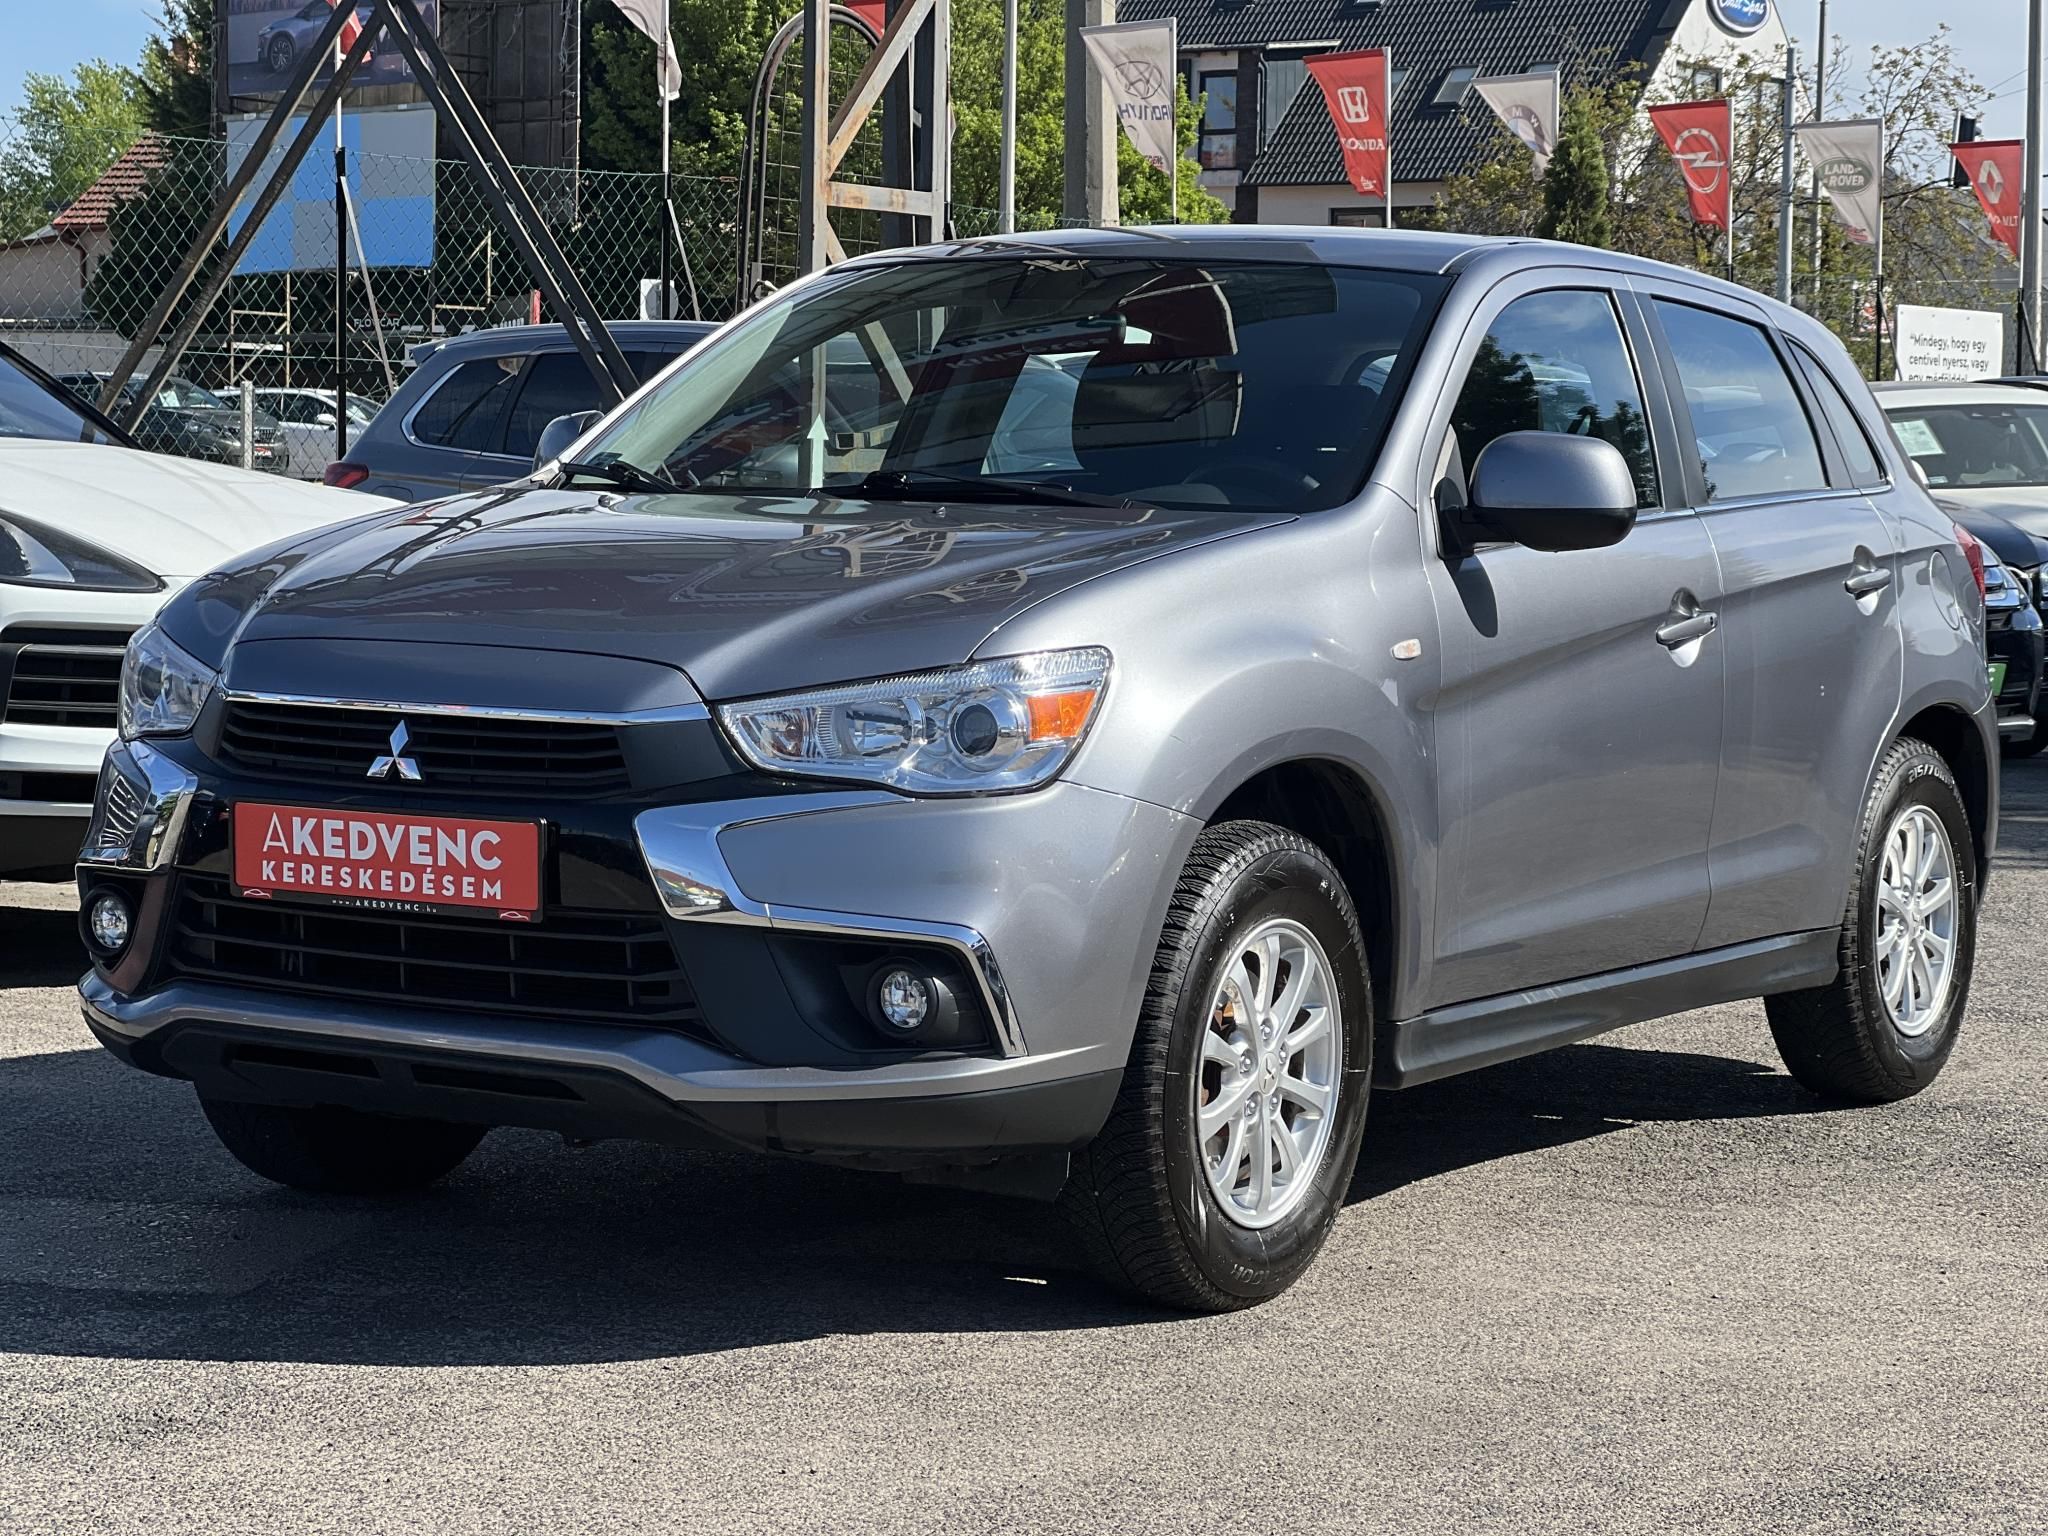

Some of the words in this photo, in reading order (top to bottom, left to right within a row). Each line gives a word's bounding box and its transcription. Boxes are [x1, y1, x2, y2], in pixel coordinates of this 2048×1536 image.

[1951, 336, 1971, 353] hogy
[1972, 340, 1987, 354] egy
[1971, 359, 1989, 372] vagy
[262, 811, 502, 871] AKEDVENC
[262, 860, 502, 900] KERESKEDÉSEM
